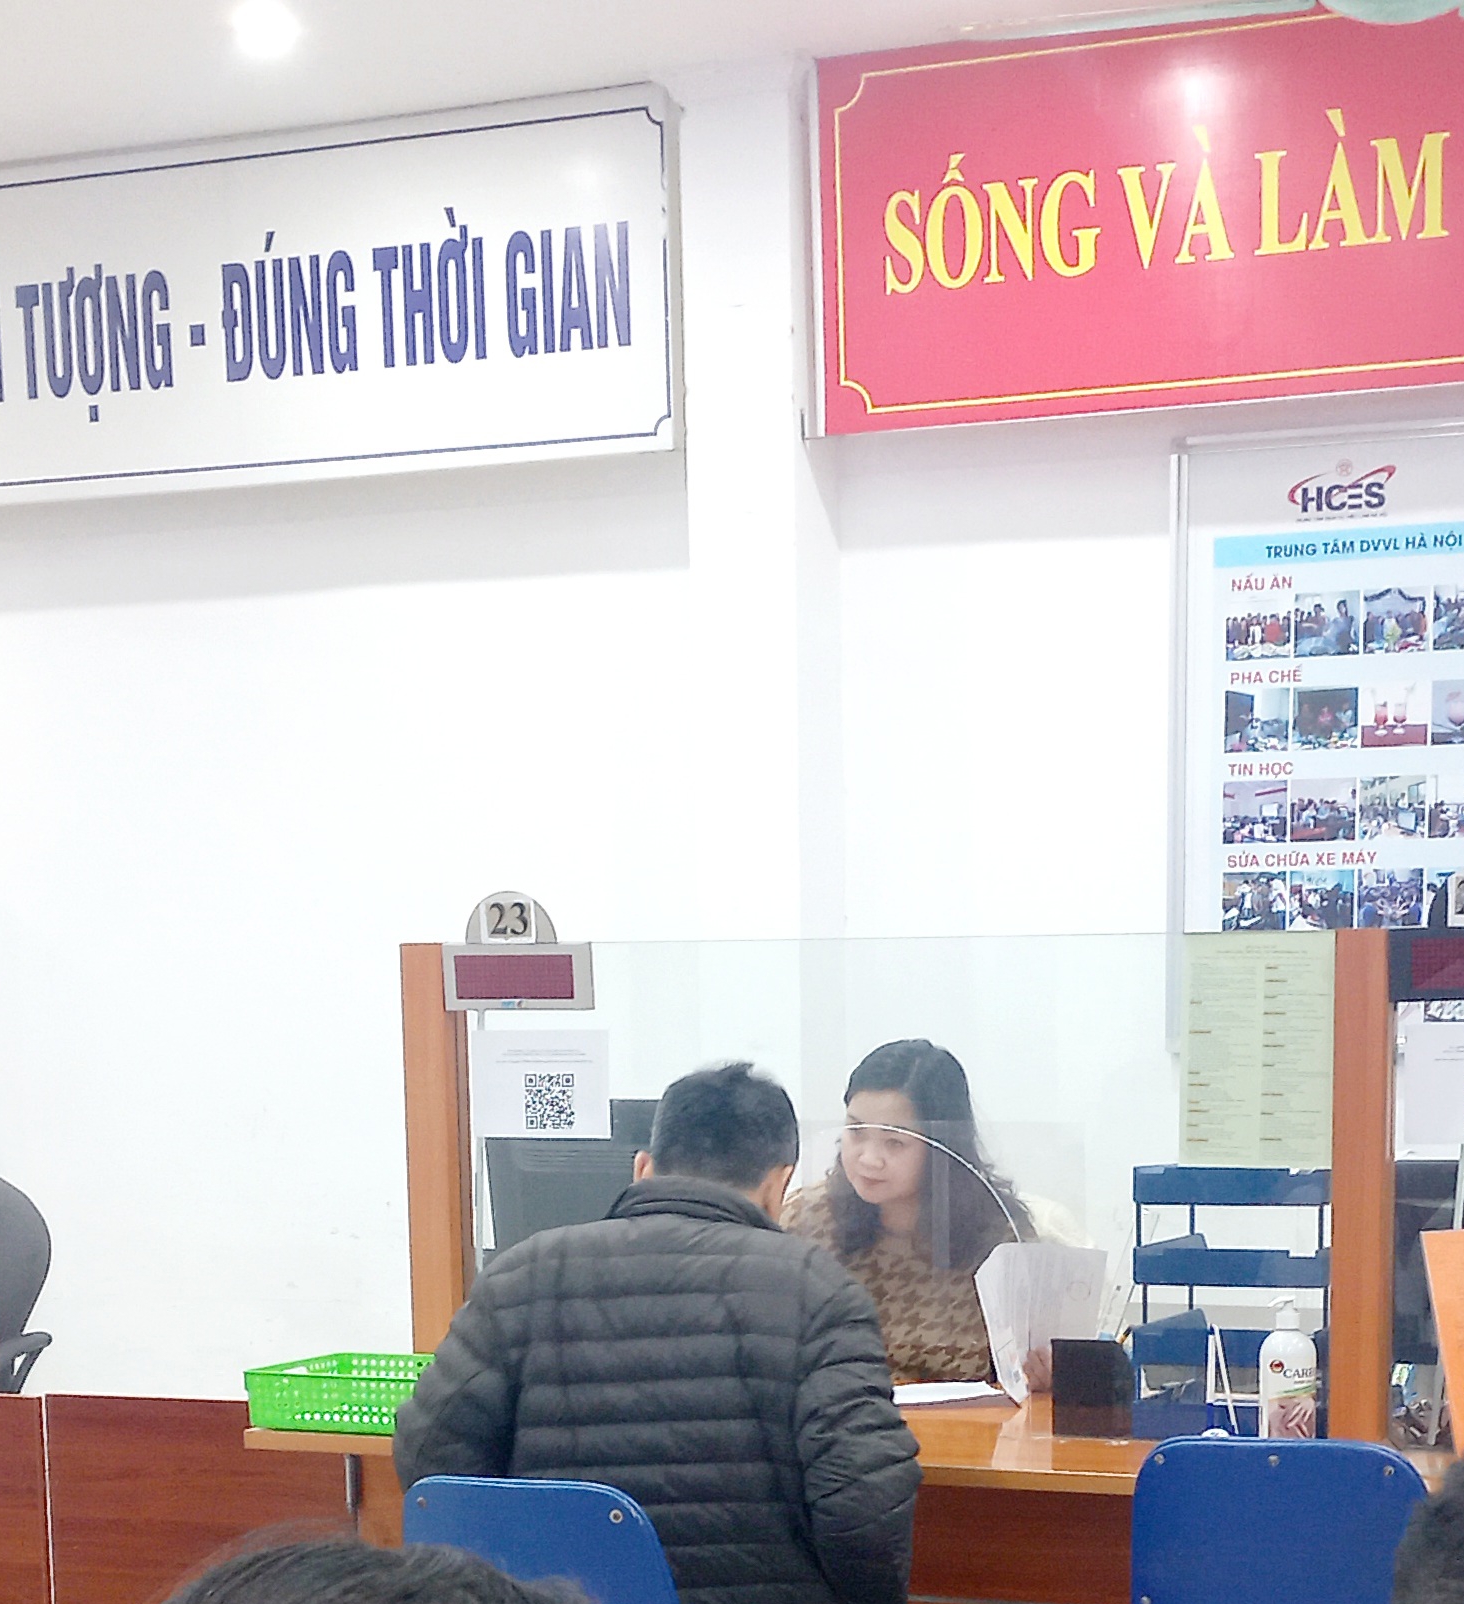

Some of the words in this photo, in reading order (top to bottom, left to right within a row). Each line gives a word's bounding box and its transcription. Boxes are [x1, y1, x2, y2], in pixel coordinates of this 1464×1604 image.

[883, 152, 1102, 296] SỐNG
[1117, 124, 1235, 270] VÀ
[1254, 108, 1450, 257] LÀM
[14, 263, 174, 423] TƯỢNG
[221, 231, 358, 383] ĐÚNG
[372, 206, 487, 368] THỜI
[505, 220, 632, 358] GIAN
[1301, 482, 1386, 513] HCES
[1265, 542, 1317, 559] TRUNG
[1359, 537, 1400, 553] DVVL
[1405, 531, 1428, 549] HÀ
[1433, 530, 1463, 551] NỘI
[1230, 671, 1263, 685] PHA
[1228, 763, 1253, 777] TIN
[1259, 761, 1294, 780] HỌC
[1265, 850, 1310, 867] CHỮA
[1316, 852, 1336, 866] XE
[1342, 848, 1377, 865] MÁY
[489, 902, 529, 936] 23
